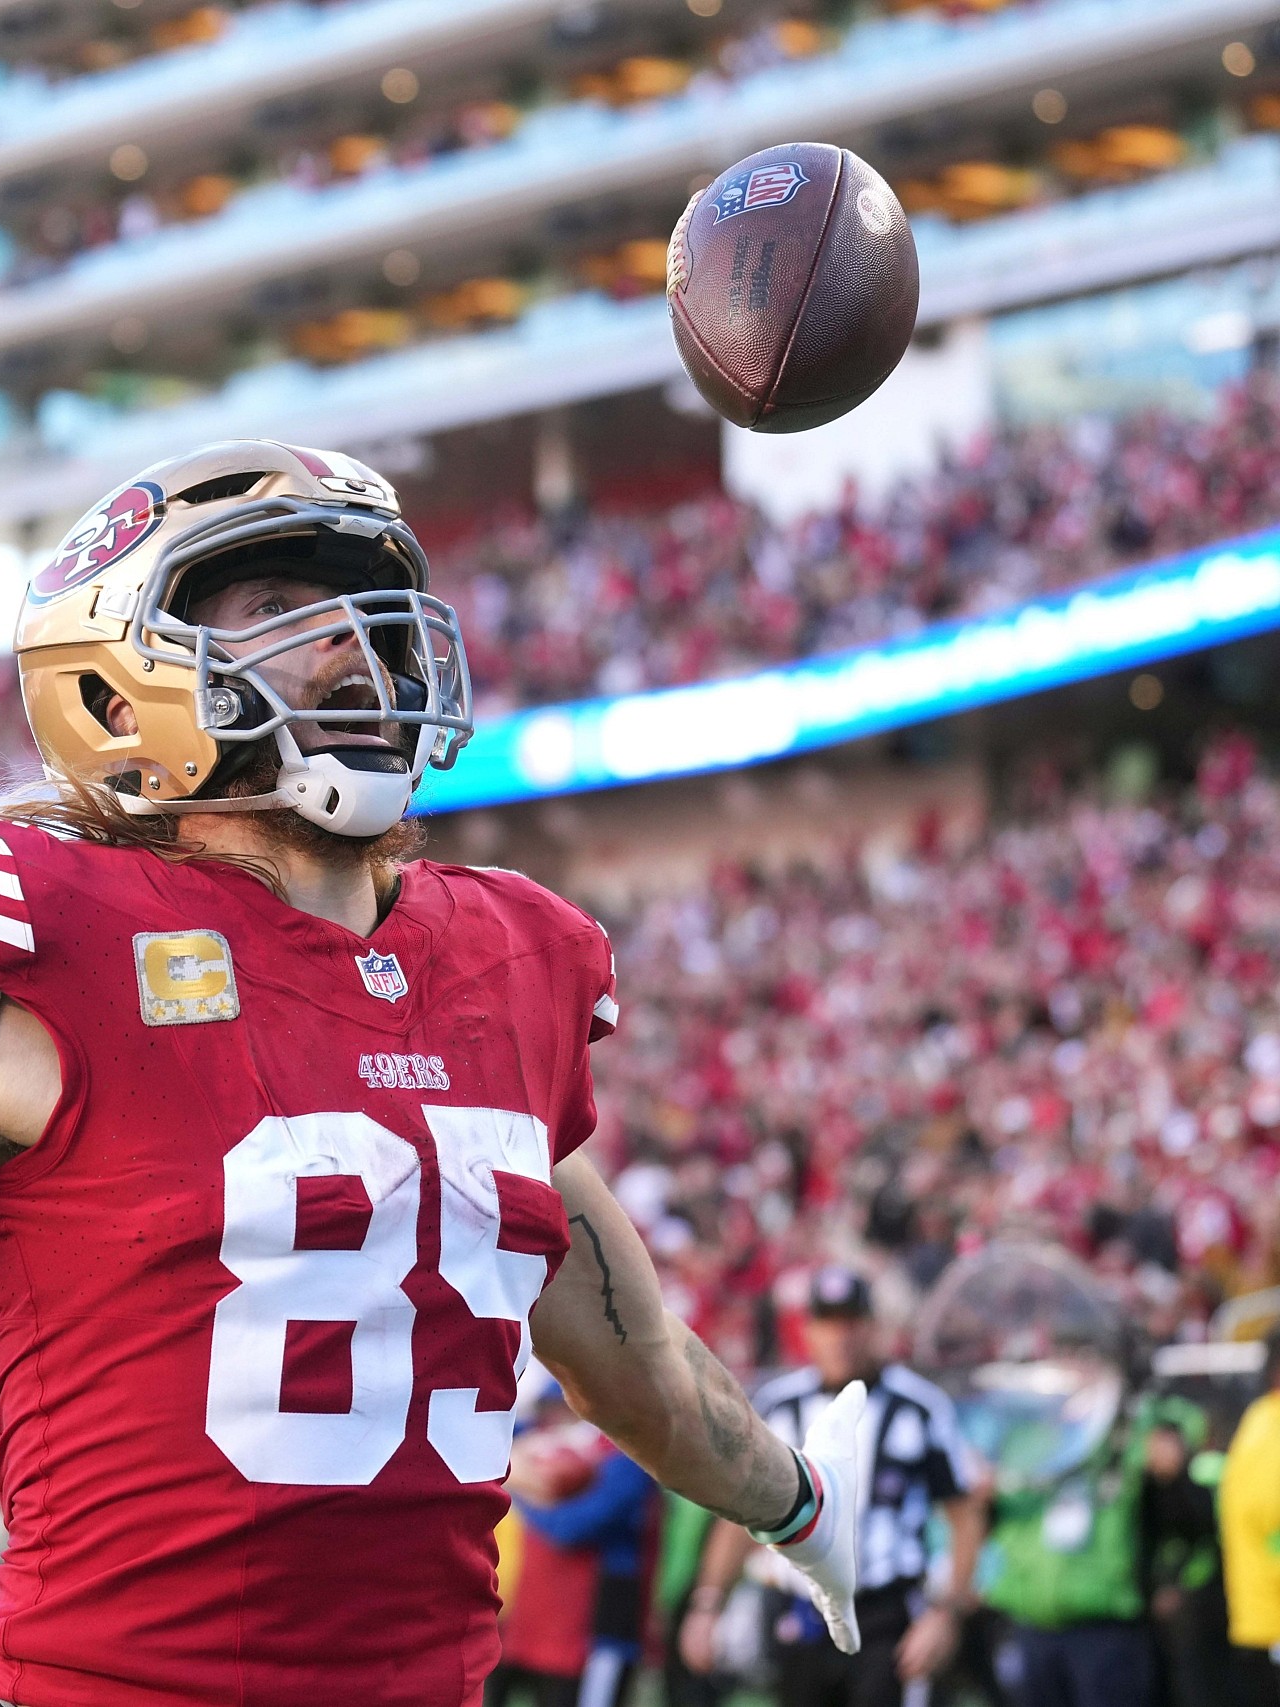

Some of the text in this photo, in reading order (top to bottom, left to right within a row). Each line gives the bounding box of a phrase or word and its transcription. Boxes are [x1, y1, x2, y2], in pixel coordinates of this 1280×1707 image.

[747, 166, 795, 205] NFL
[143, 937, 228, 1001] C
[368, 971, 401, 993] NFL
[358, 1052, 450, 1090] 49ERS
[205, 1104, 550, 1485] 85
